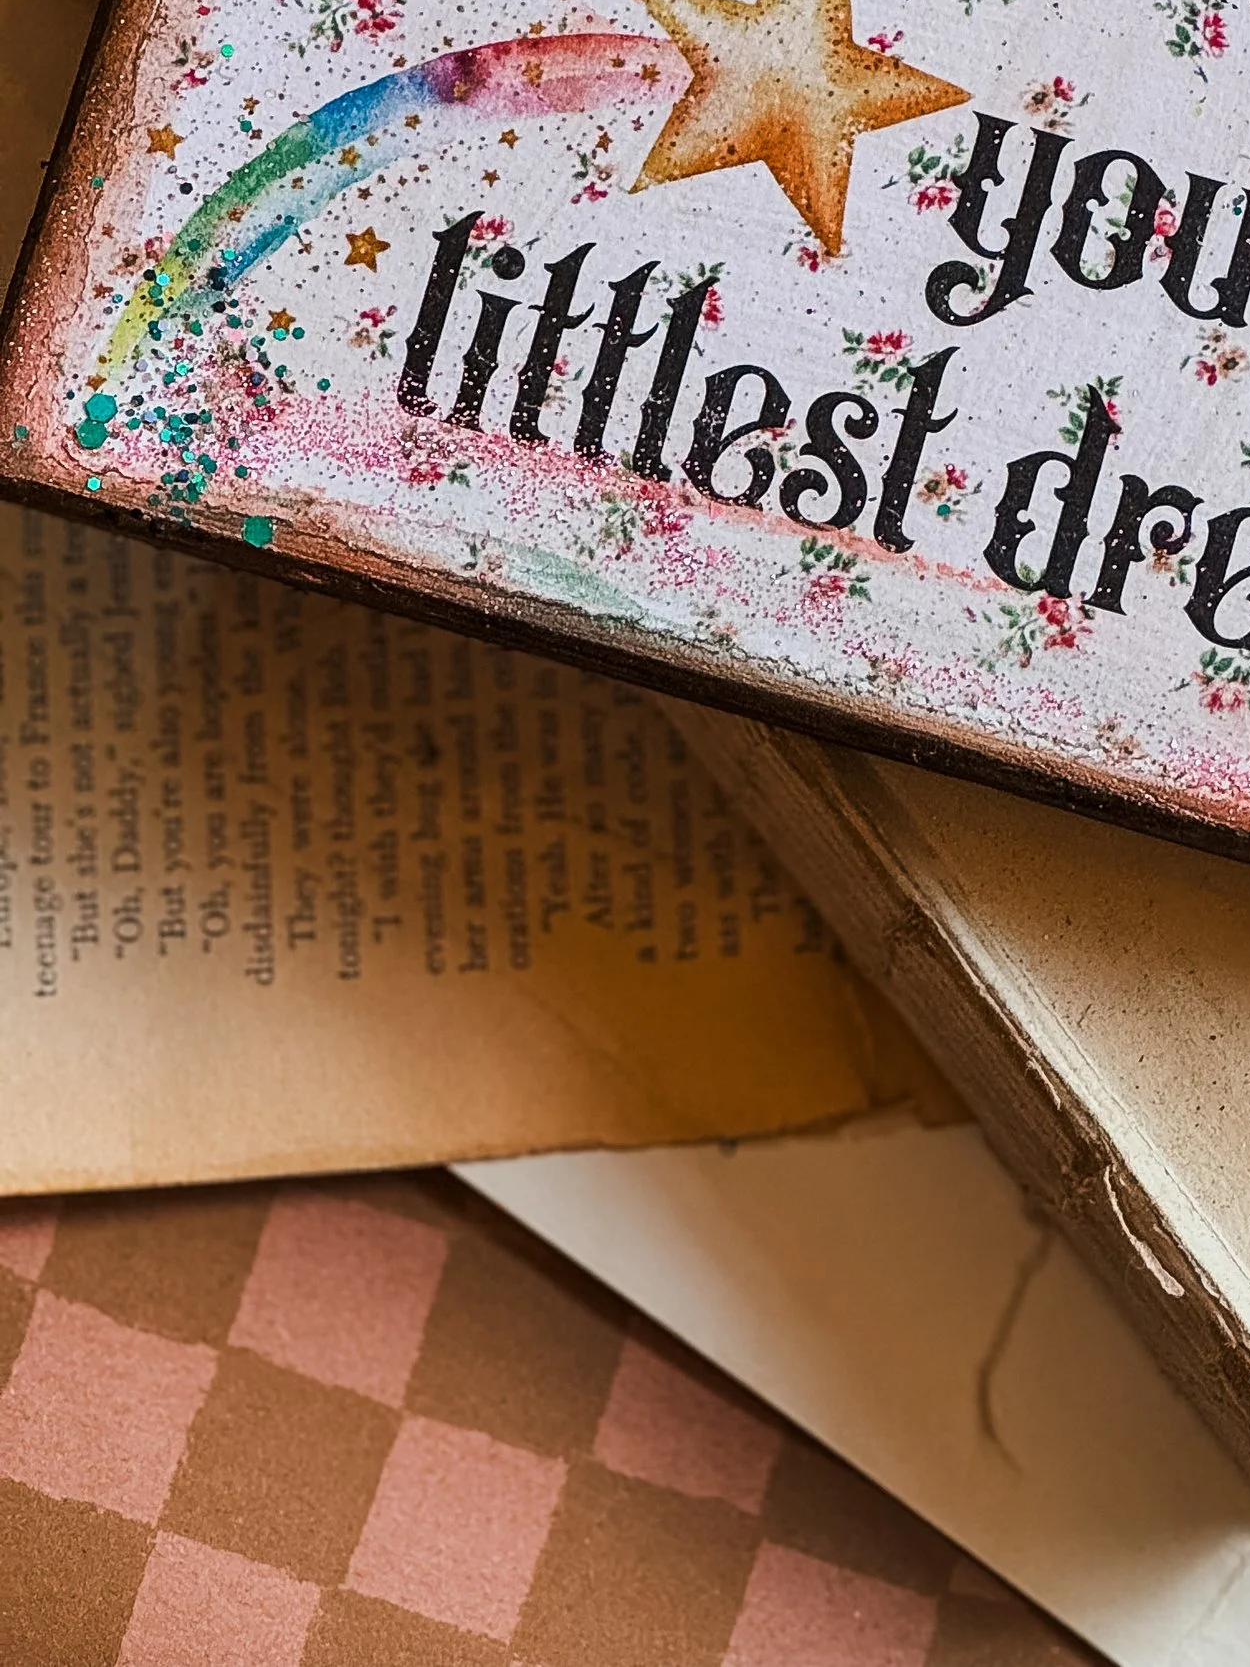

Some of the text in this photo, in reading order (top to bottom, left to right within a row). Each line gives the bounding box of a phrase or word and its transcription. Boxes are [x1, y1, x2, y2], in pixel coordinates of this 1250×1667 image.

[396, 210, 960, 554] littlest
[17, 636, 50, 746] France
[23, 757, 52, 791] to
[67, 743, 94, 792] not
[147, 704, 182, 768] also
[236, 710, 267, 785] from
[201, 752, 226, 801] are
[286, 774, 312, 851] were
[318, 719, 361, 842] thought
[27, 801, 54, 866] tour
[64, 806, 98, 876] she's
[150, 778, 192, 873] you're
[204, 812, 235, 869] you
[239, 800, 278, 985] disdainfully
[283, 866, 322, 949] They
[324, 850, 363, 980] tonight?
[27, 876, 62, 997] teenage
